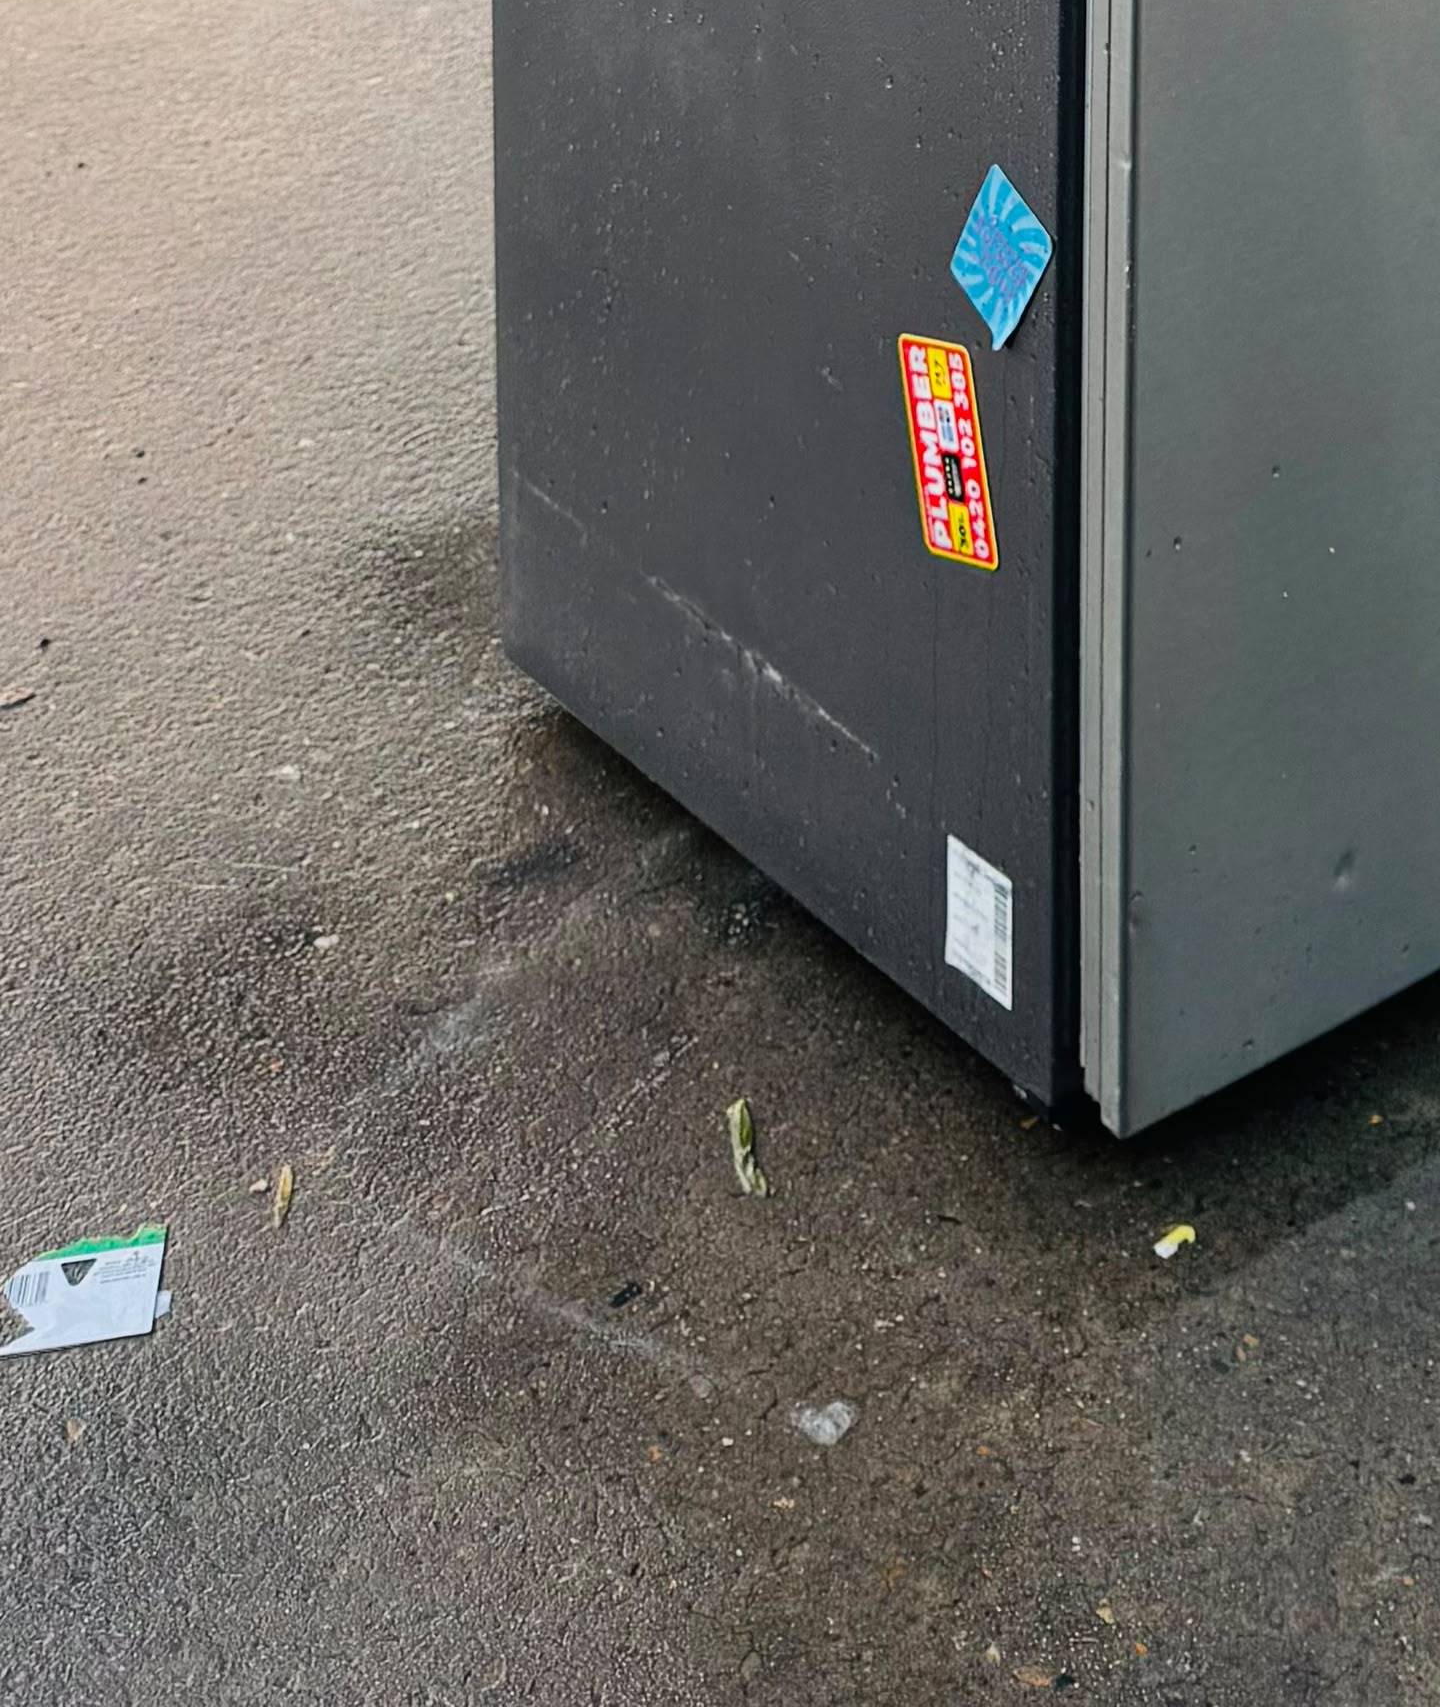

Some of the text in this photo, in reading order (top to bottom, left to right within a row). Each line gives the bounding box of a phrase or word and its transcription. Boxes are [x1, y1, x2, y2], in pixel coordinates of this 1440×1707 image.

[908, 345, 952, 550] PLUMBER
[957, 418, 977, 469] 102
[964, 479, 989, 560] 0420
